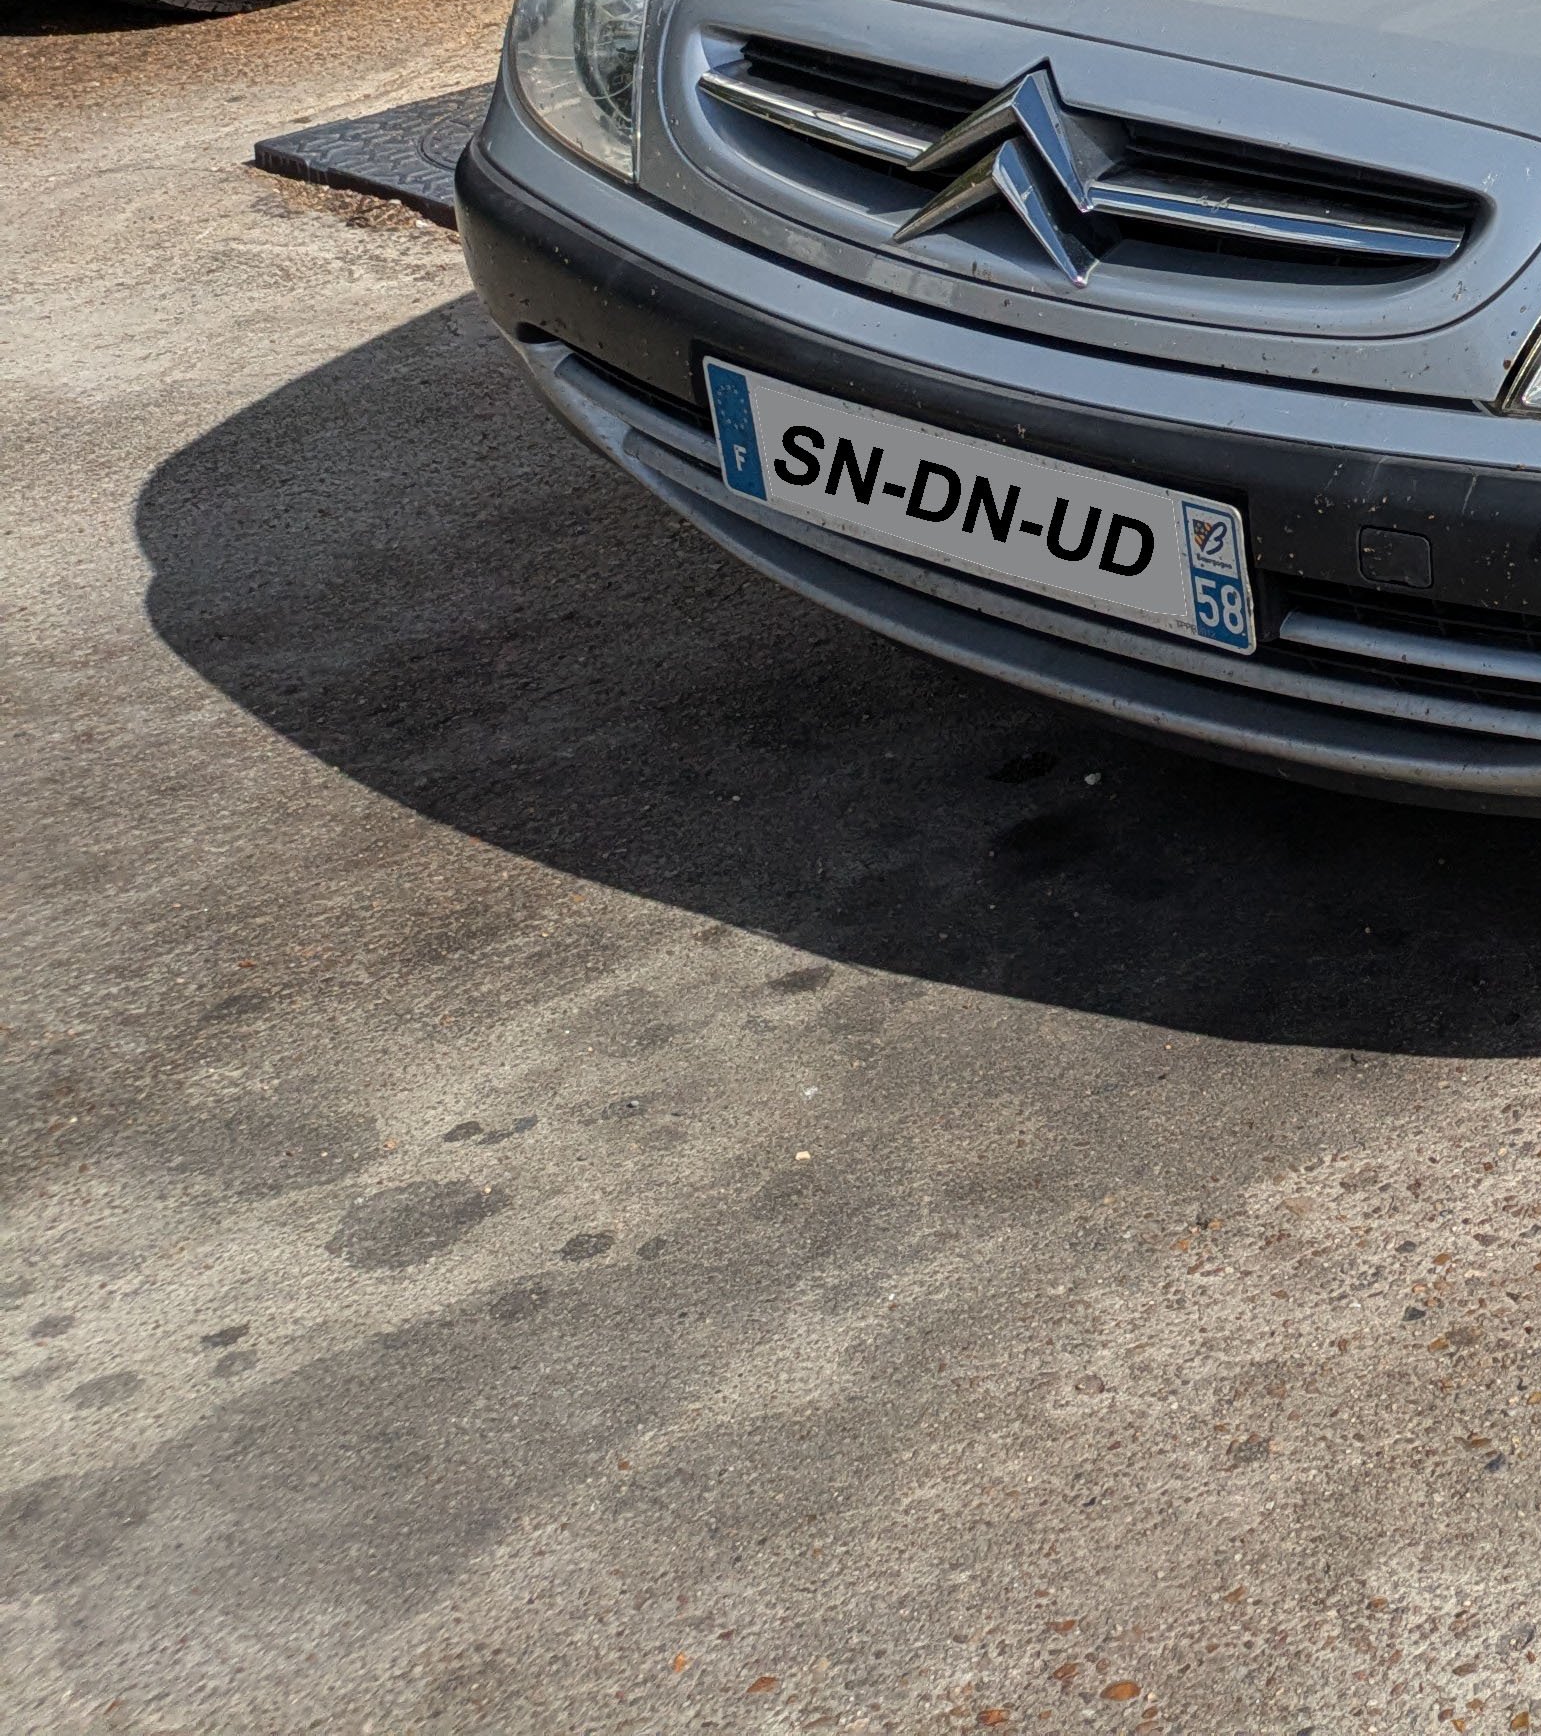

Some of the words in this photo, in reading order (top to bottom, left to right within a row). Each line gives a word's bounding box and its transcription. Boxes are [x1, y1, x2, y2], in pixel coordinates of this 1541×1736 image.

[733, 444, 747, 472] F
[773, 425, 1156, 578] SN-DN-UD
[1195, 576, 1244, 635] 58
